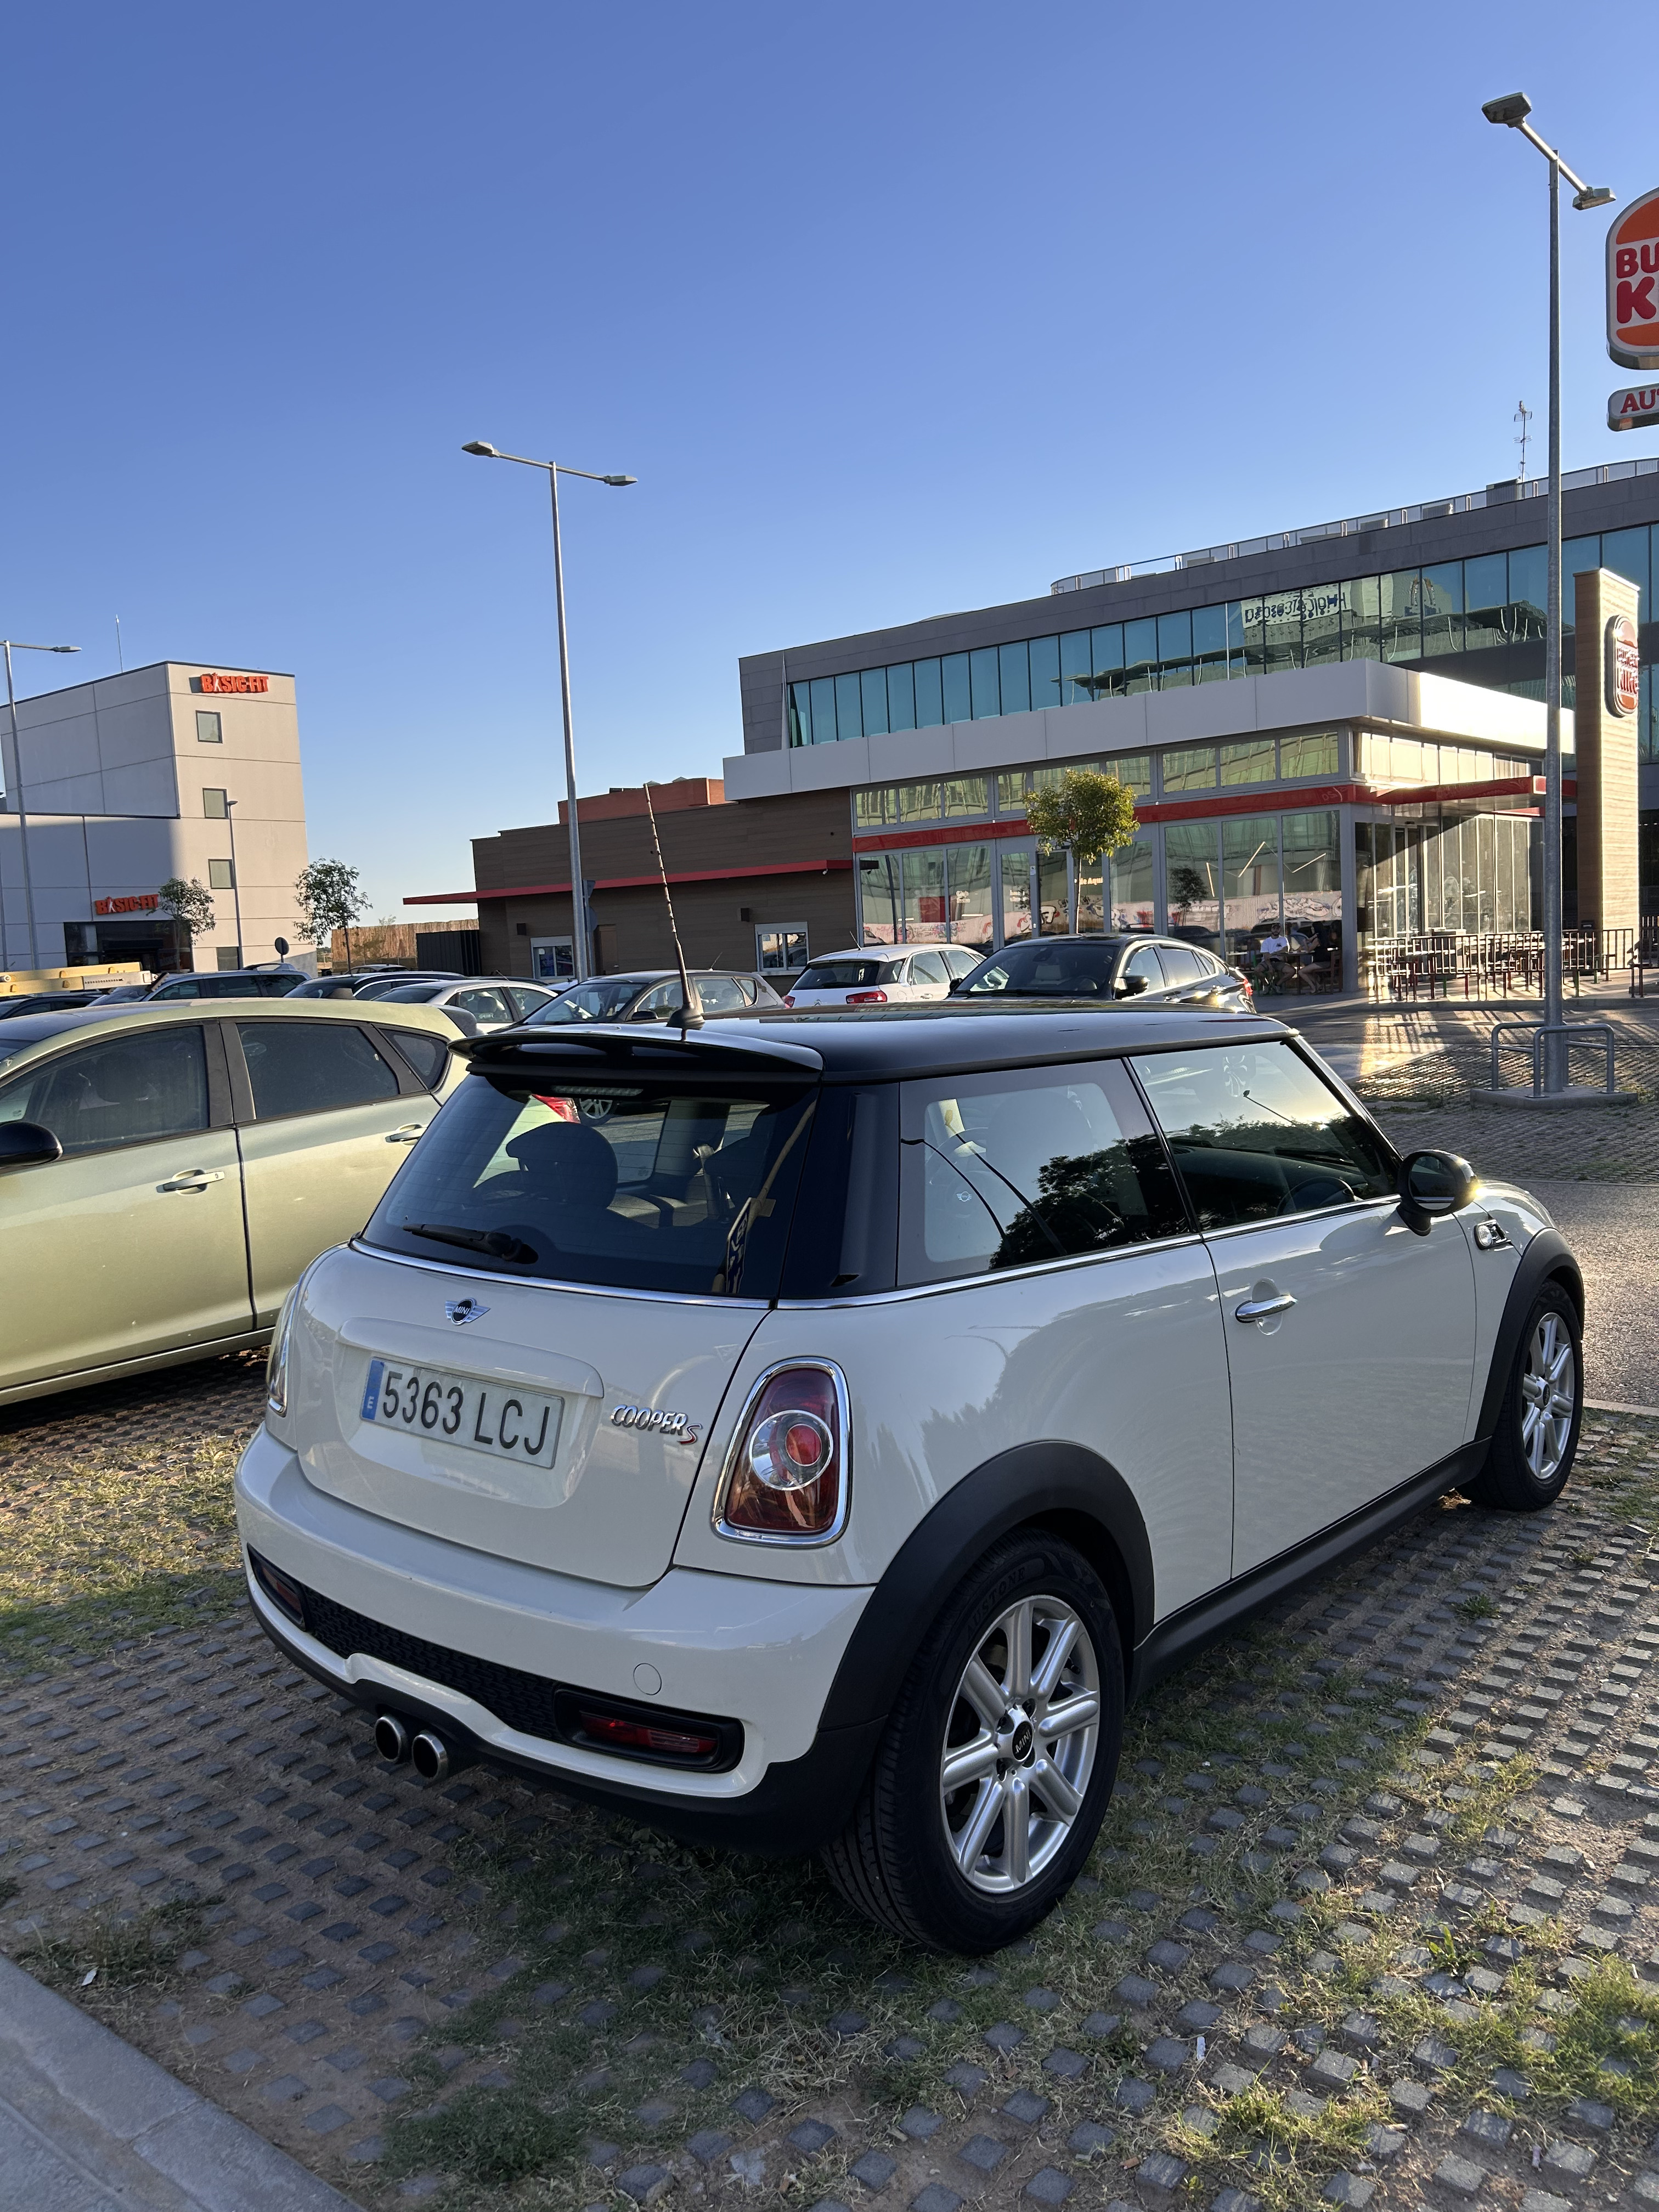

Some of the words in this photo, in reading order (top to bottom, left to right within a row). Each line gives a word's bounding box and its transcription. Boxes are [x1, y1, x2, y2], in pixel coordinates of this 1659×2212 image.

[1620, 388, 1659, 414] AU
[201, 673, 268, 693] BASIC-FIT
[454, 1306, 470, 1315] MINI
[367, 1396, 375, 1409] E
[383, 1370, 464, 1434] 5363
[475, 1392, 550, 1455] LCJ
[611, 1404, 688, 1436] COOPER
[677, 1423, 703, 1445] S
[1015, 1729, 1032, 1754] MINI
